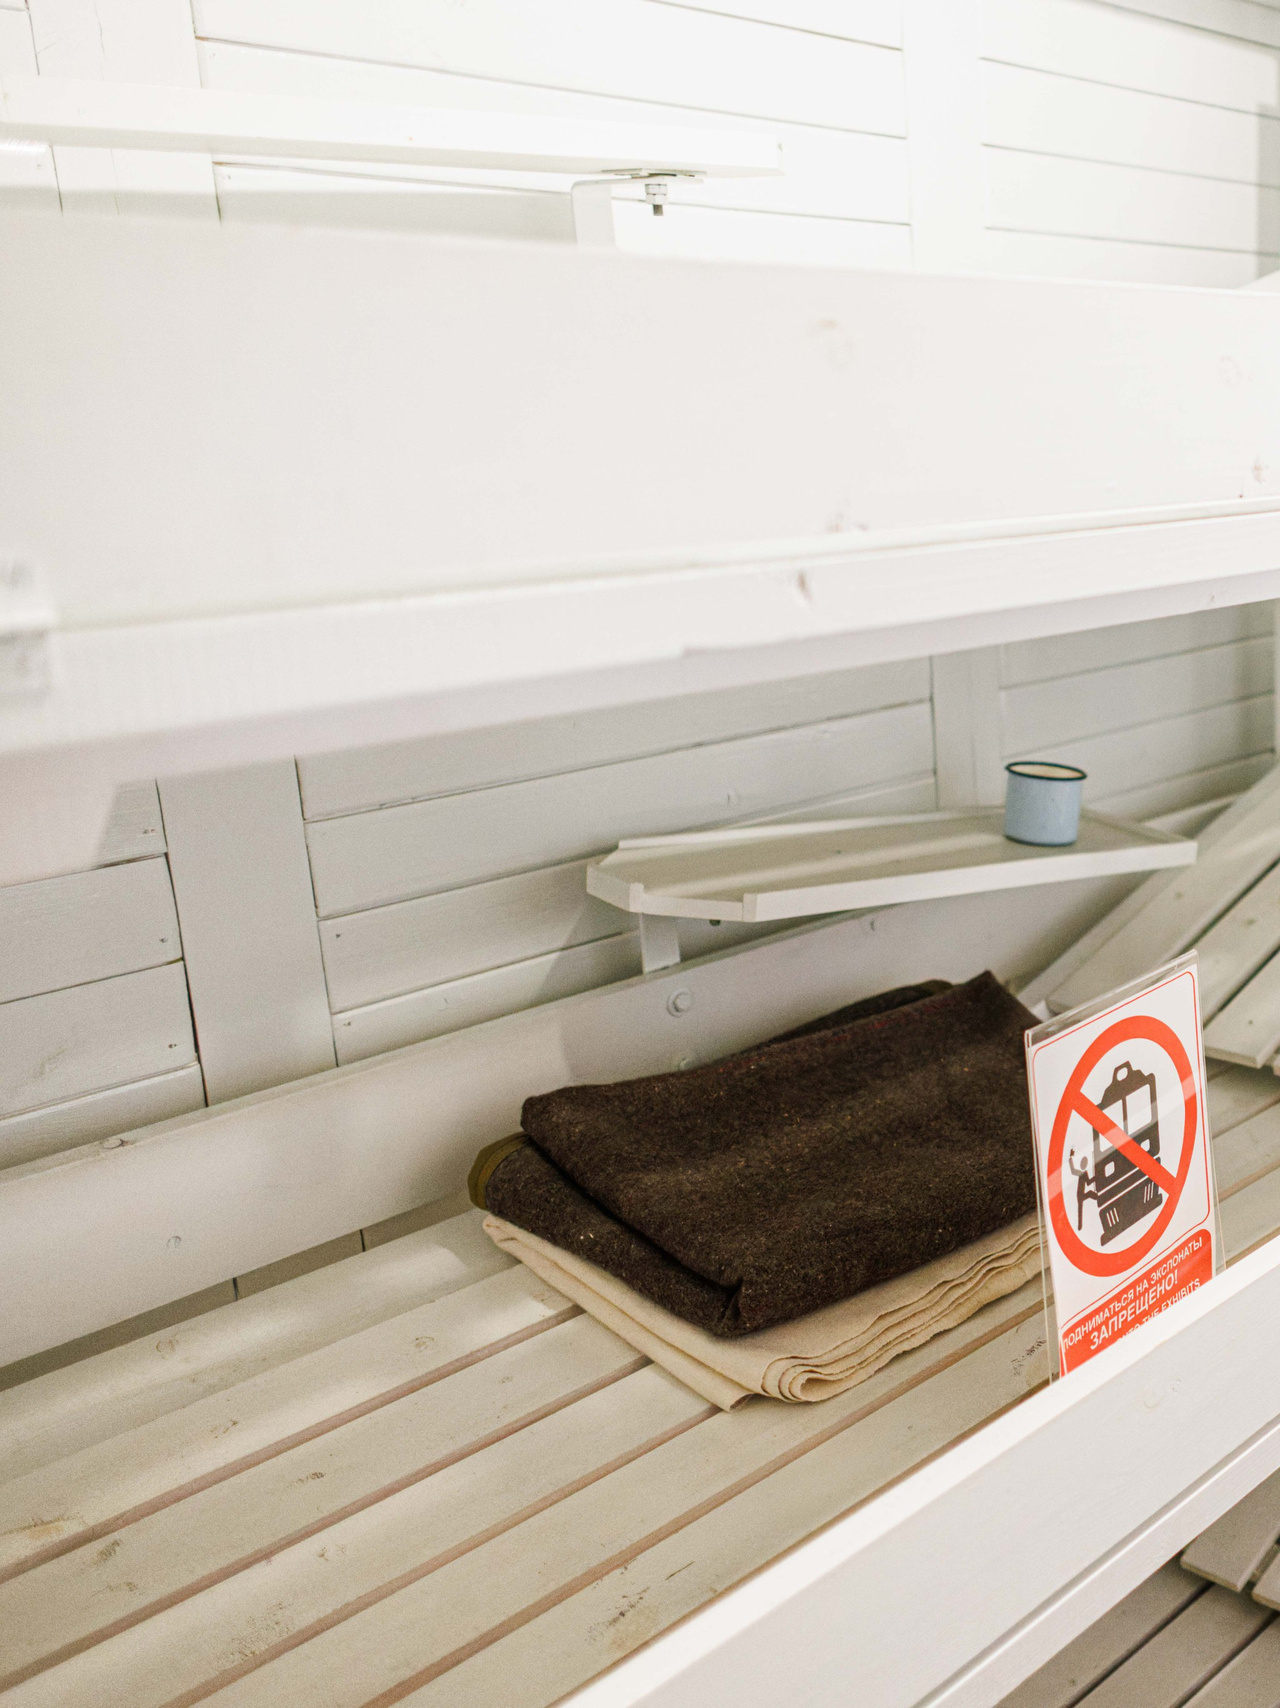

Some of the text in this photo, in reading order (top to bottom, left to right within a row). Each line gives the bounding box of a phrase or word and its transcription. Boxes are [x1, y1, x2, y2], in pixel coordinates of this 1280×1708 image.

[1063, 1236, 1203, 1350] ПОДНИМАТЬСЯ НА ЭКСПОНАТЫ
[1090, 1269, 1179, 1350] ЗАПРЕЩЕНО!
[1162, 1278, 1201, 1312] EXHIBITS
